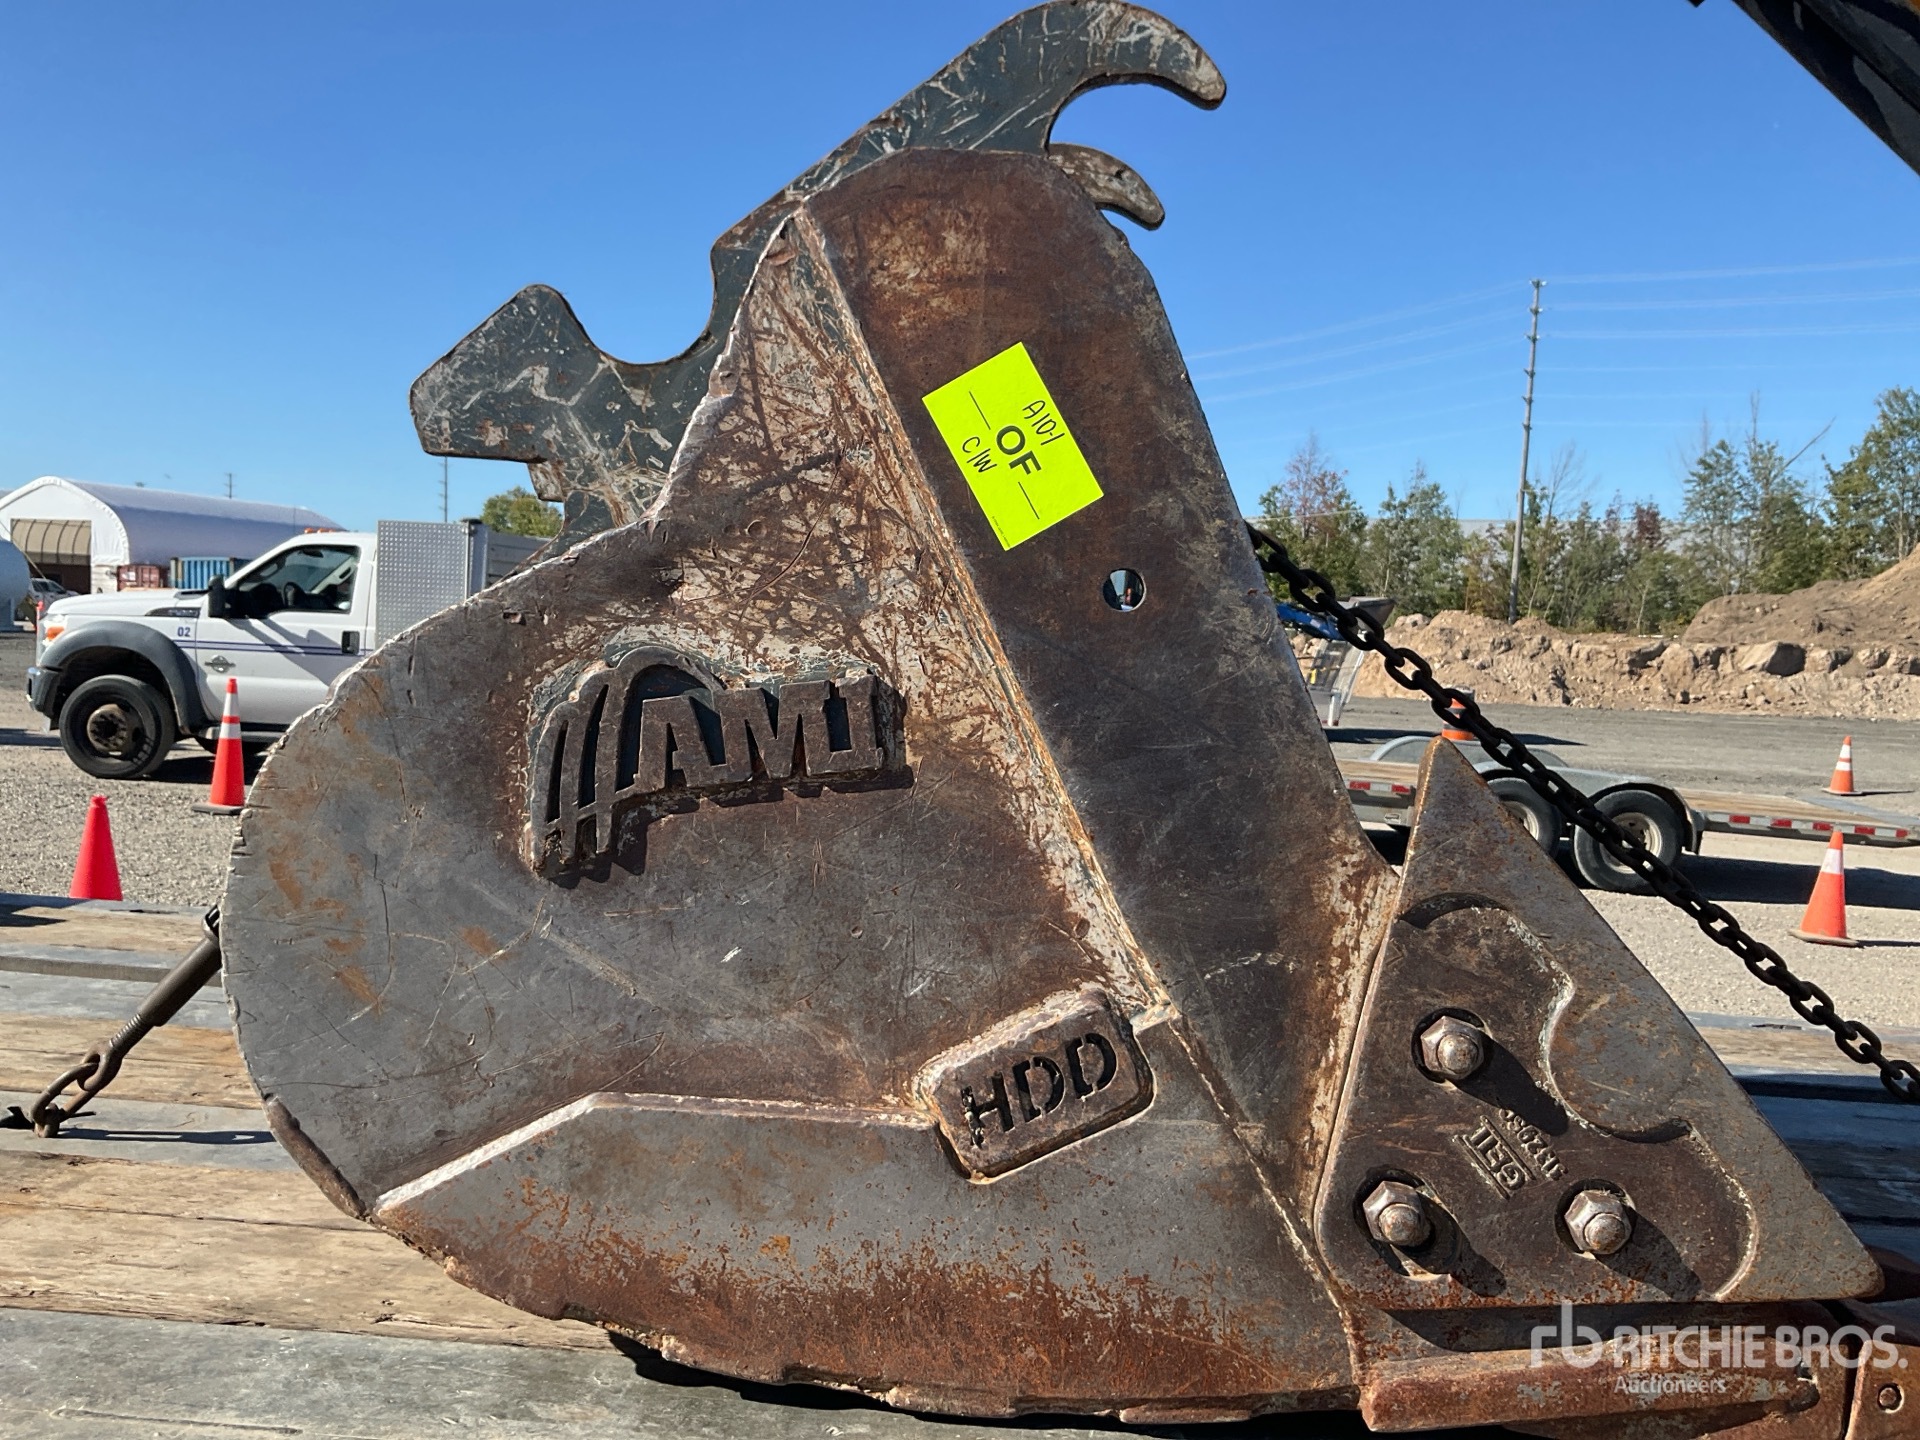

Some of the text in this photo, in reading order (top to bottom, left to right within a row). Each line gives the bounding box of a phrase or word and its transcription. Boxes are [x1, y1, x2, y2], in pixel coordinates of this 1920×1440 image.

[996, 425, 1042, 475] OF
[177, 626, 191, 638] 02
[960, 1032, 1117, 1148] HDD
